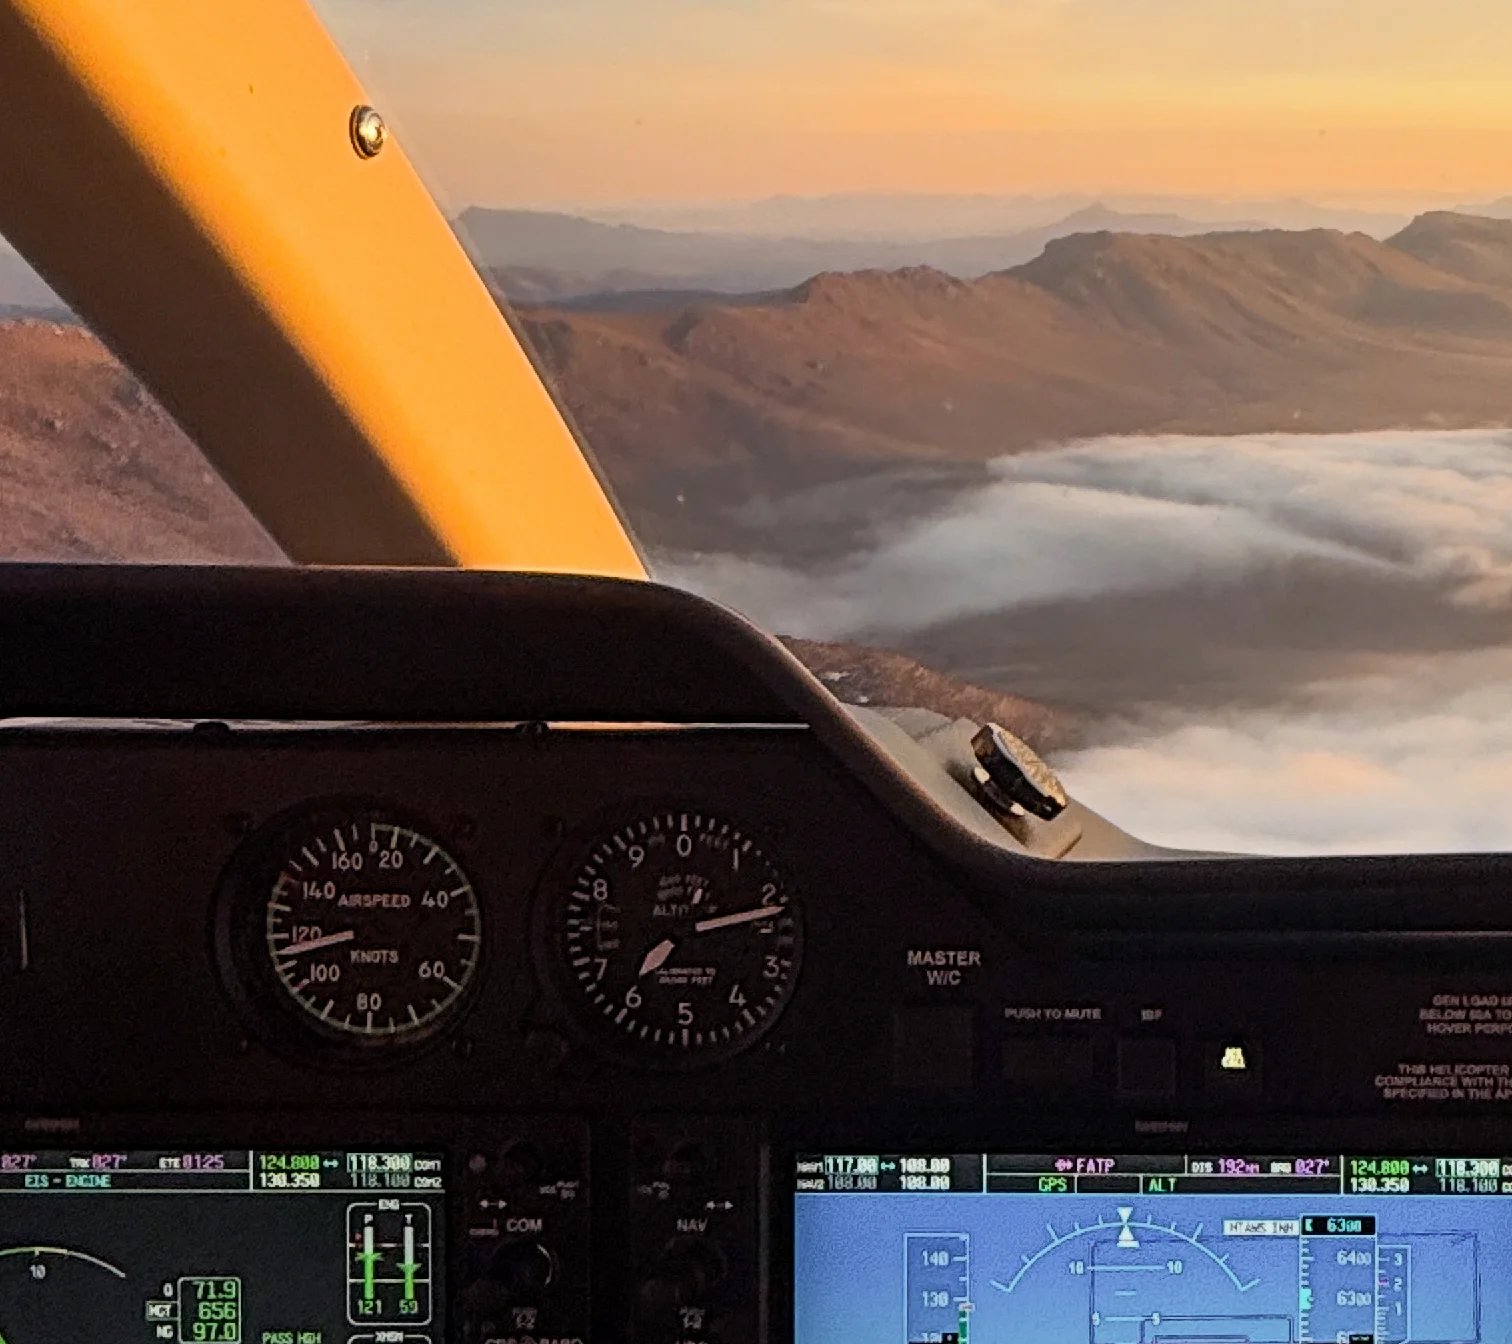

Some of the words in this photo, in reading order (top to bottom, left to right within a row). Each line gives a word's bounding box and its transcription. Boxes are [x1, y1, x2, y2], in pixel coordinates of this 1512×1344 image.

[676, 834, 692, 857] 0
[332, 852, 363, 870] 160
[379, 850, 403, 869] 20
[628, 846, 645, 870] 9
[732, 848, 740, 872] 1
[303, 881, 336, 899] 140
[592, 878, 609, 901] 8
[761, 883, 777, 906] 2
[338, 894, 411, 908] AIRSPEED
[421, 891, 449, 908] 40
[350, 949, 399, 964] KNOTS
[907, 951, 981, 967] MASTER
[310, 964, 341, 982] 100
[418, 961, 445, 980] 60
[594, 958, 608, 981] 7
[763, 955, 780, 978] 3
[926, 969, 962, 986] W/C
[356, 993, 382, 1011] 80
[625, 985, 642, 1009] 6
[729, 984, 747, 1007] 4
[678, 1003, 694, 1026] 5
[1004, 1007, 1042, 1021] PUSH
[1044, 1007, 1062, 1021] TO
[1064, 1007, 1102, 1021] MUTE
[1430, 1065, 1509, 1075] HELICOPTER
[1375, 1076, 1458, 1087] COMPLIANCE
[1462, 1077, 1494, 1087] WITH
[260, 1154, 320, 1170] 124.800
[1076, 1159, 1116, 1173] FATP
[1350, 1159, 1410, 1176] 124.800
[1437, 1160, 1499, 1176] 118.300
[25, 1174, 49, 1188] EIS
[65, 1174, 112, 1188] ENGINE
[1039, 1177, 1067, 1192] GPS
[1149, 1177, 1178, 1192] ALT
[1350, 1177, 1410, 1193] 130.350
[507, 1218, 542, 1232] COM
[676, 1218, 707, 1232] NAV
[1326, 1217, 1362, 1233] 6300
[922, 1252, 949, 1266] 140
[1337, 1250, 1371, 1265] 6400
[1394, 1253, 1403, 1265] 3
[29, 1264, 46, 1280] 10
[1068, 1261, 1084, 1275] 10
[1166, 1261, 1183, 1274] 10
[1394, 1279, 1403, 1291] 2
[922, 1292, 949, 1307] 130
[1337, 1290, 1371, 1306] 6300
[198, 1301, 236, 1320] 656
[357, 1299, 382, 1314] 121
[192, 1322, 236, 1341] 97.0
